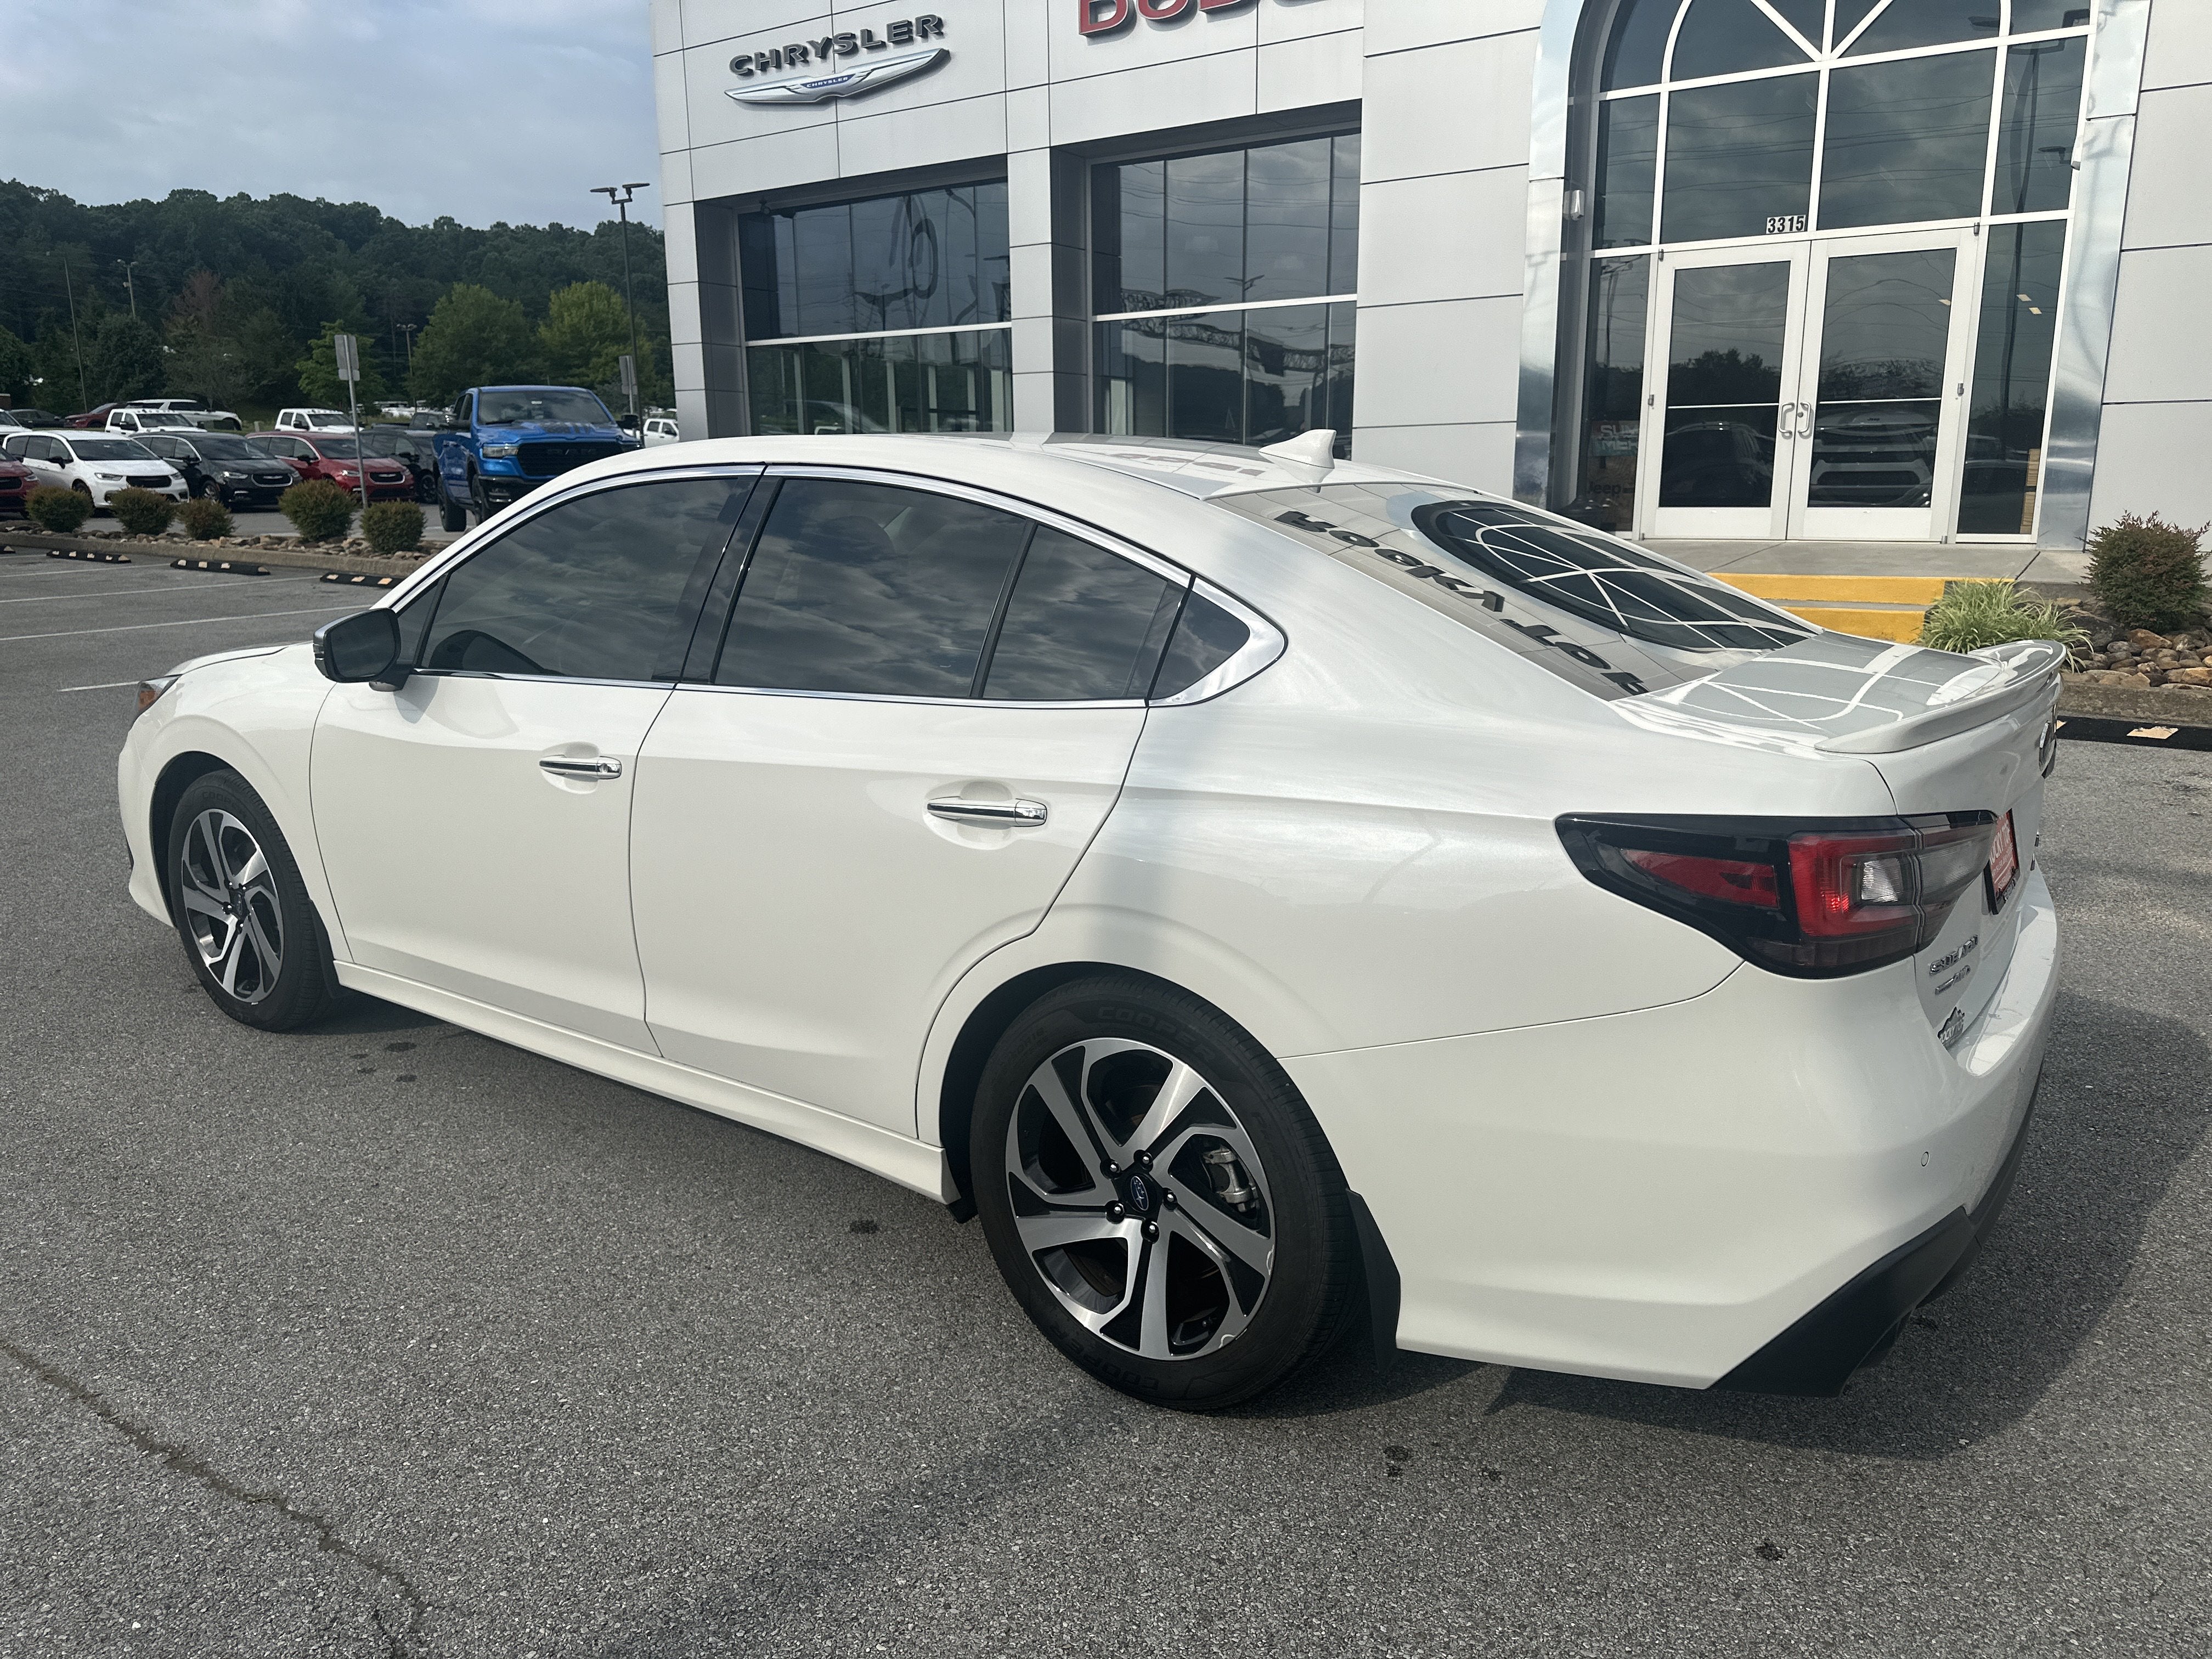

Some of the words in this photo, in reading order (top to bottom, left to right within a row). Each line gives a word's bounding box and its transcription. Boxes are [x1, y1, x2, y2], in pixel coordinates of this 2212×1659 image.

[729, 14, 943, 76] CHRYSLER
[806, 77, 848, 88] CHRYSLER
[1768, 216, 1804, 233] 3315
[1929, 934, 1978, 976] SUBARU
